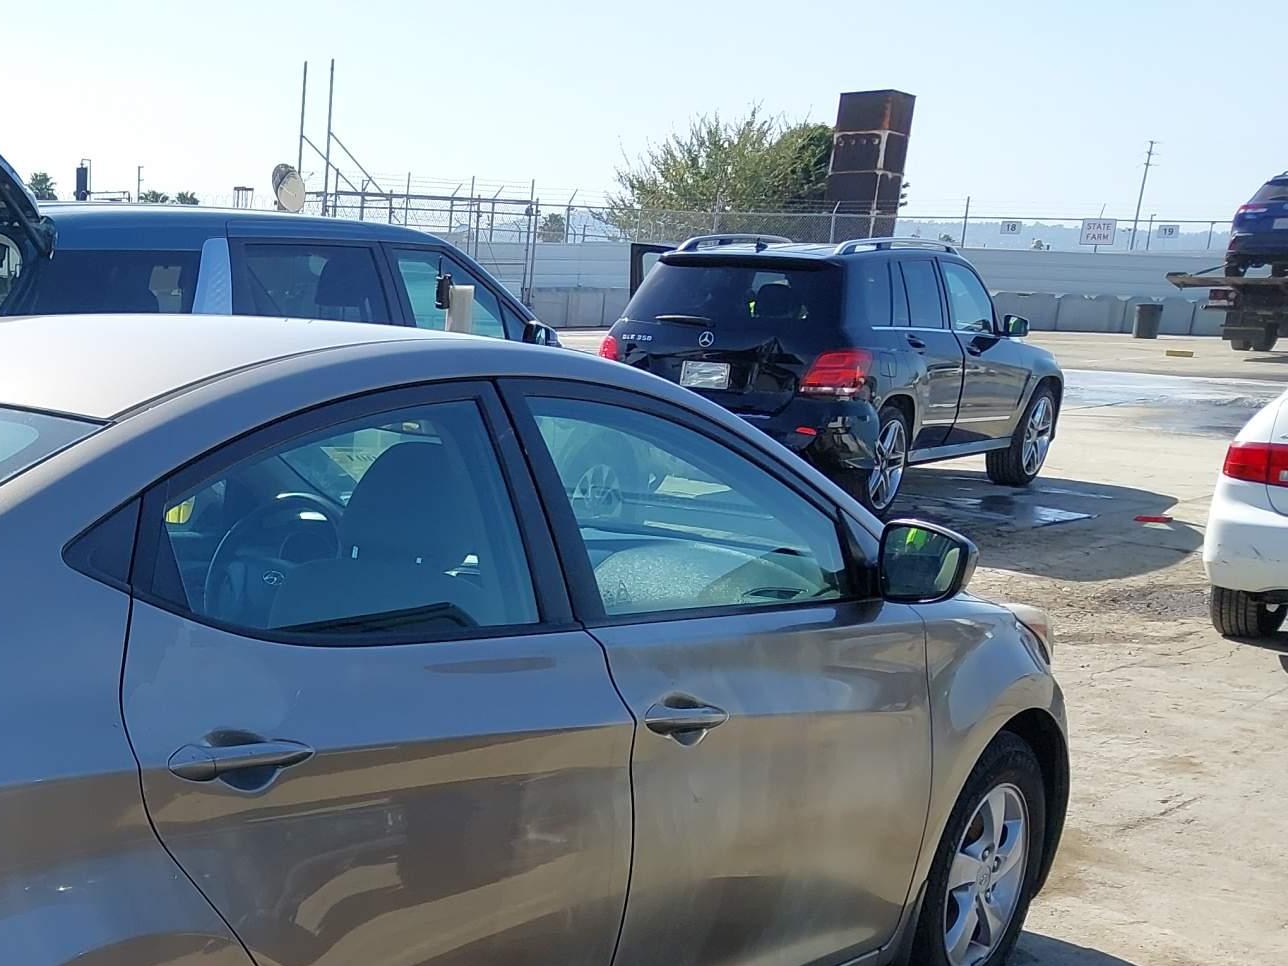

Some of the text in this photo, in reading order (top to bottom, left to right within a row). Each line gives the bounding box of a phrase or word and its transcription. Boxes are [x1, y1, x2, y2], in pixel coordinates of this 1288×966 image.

[1005, 223, 1016, 232] 18
[1086, 222, 1112, 231] STATE
[1163, 227, 1174, 236] 19
[1085, 233, 1109, 241] FARM
